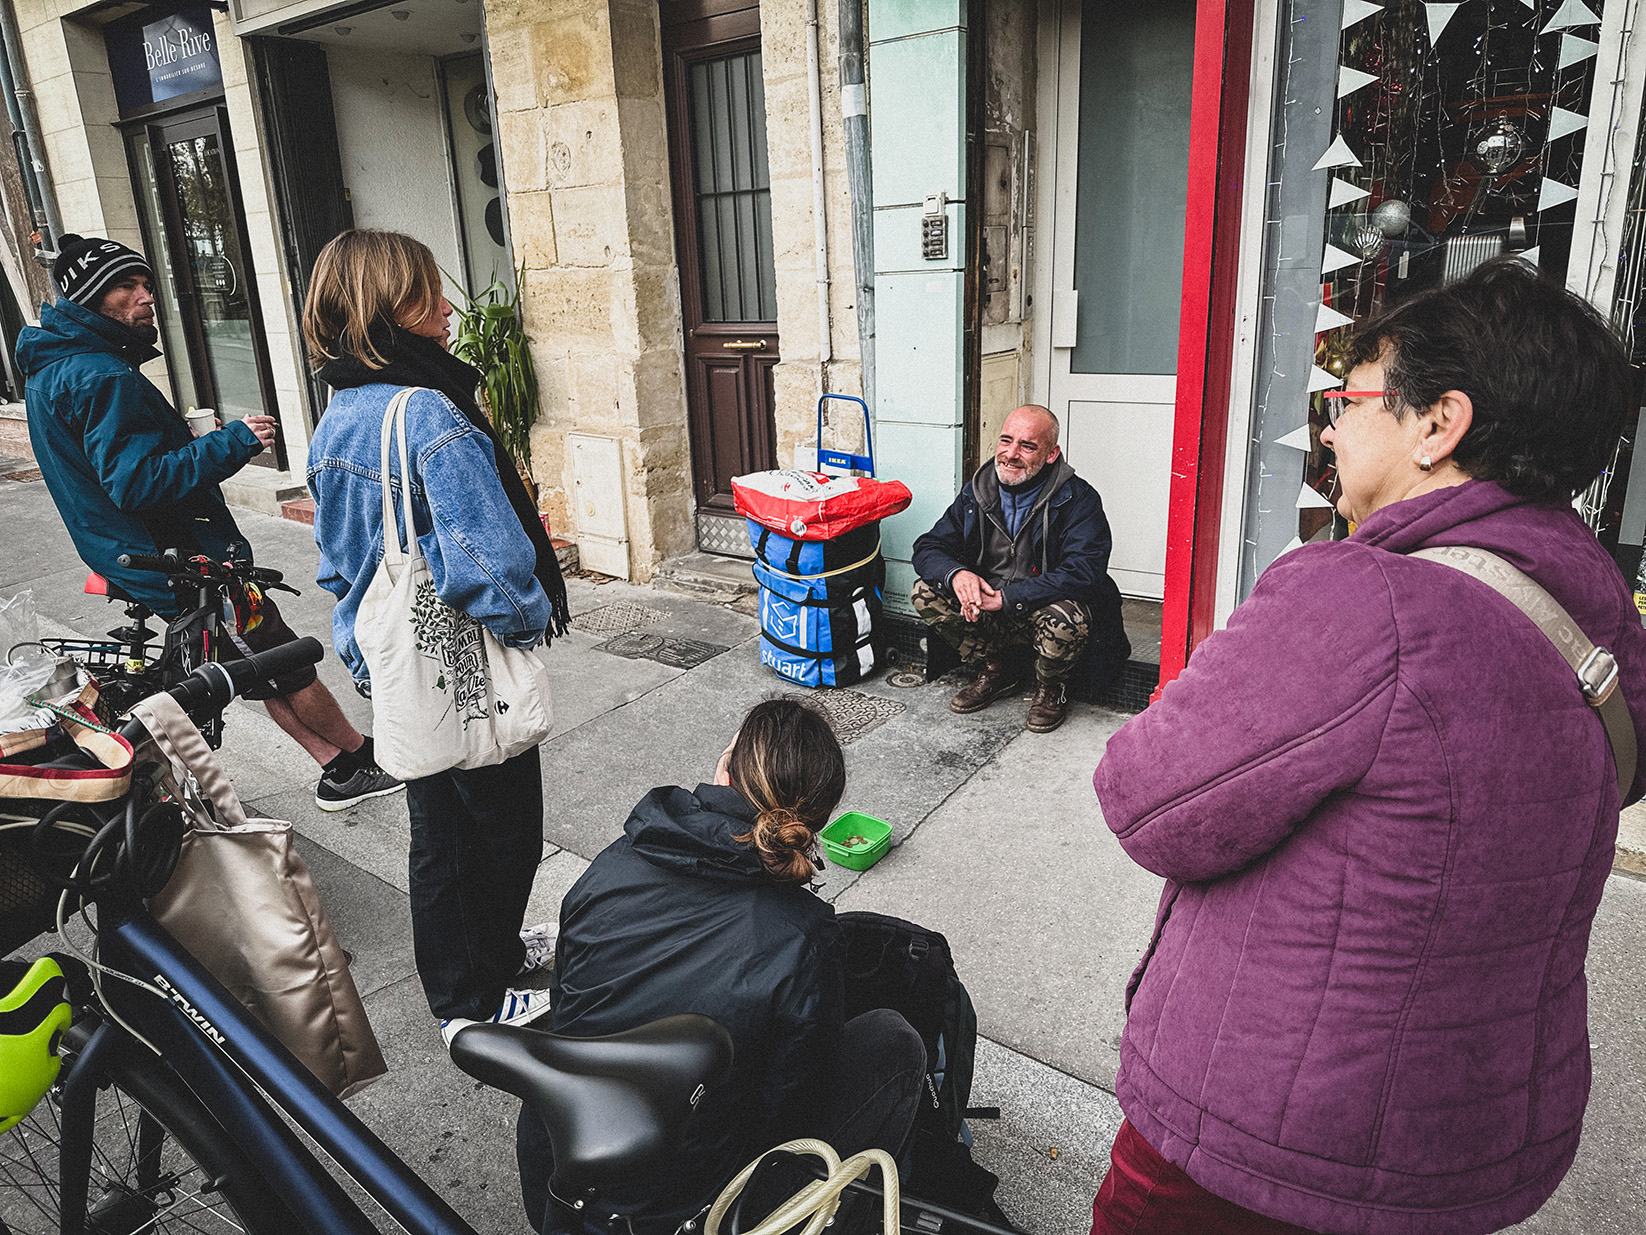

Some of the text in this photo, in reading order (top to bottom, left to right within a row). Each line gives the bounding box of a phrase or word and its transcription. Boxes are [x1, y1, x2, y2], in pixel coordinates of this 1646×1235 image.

[143, 27, 211, 71] Belle Rive
[828, 457, 846, 465] IKEA
[762, 649, 806, 681] stuart
